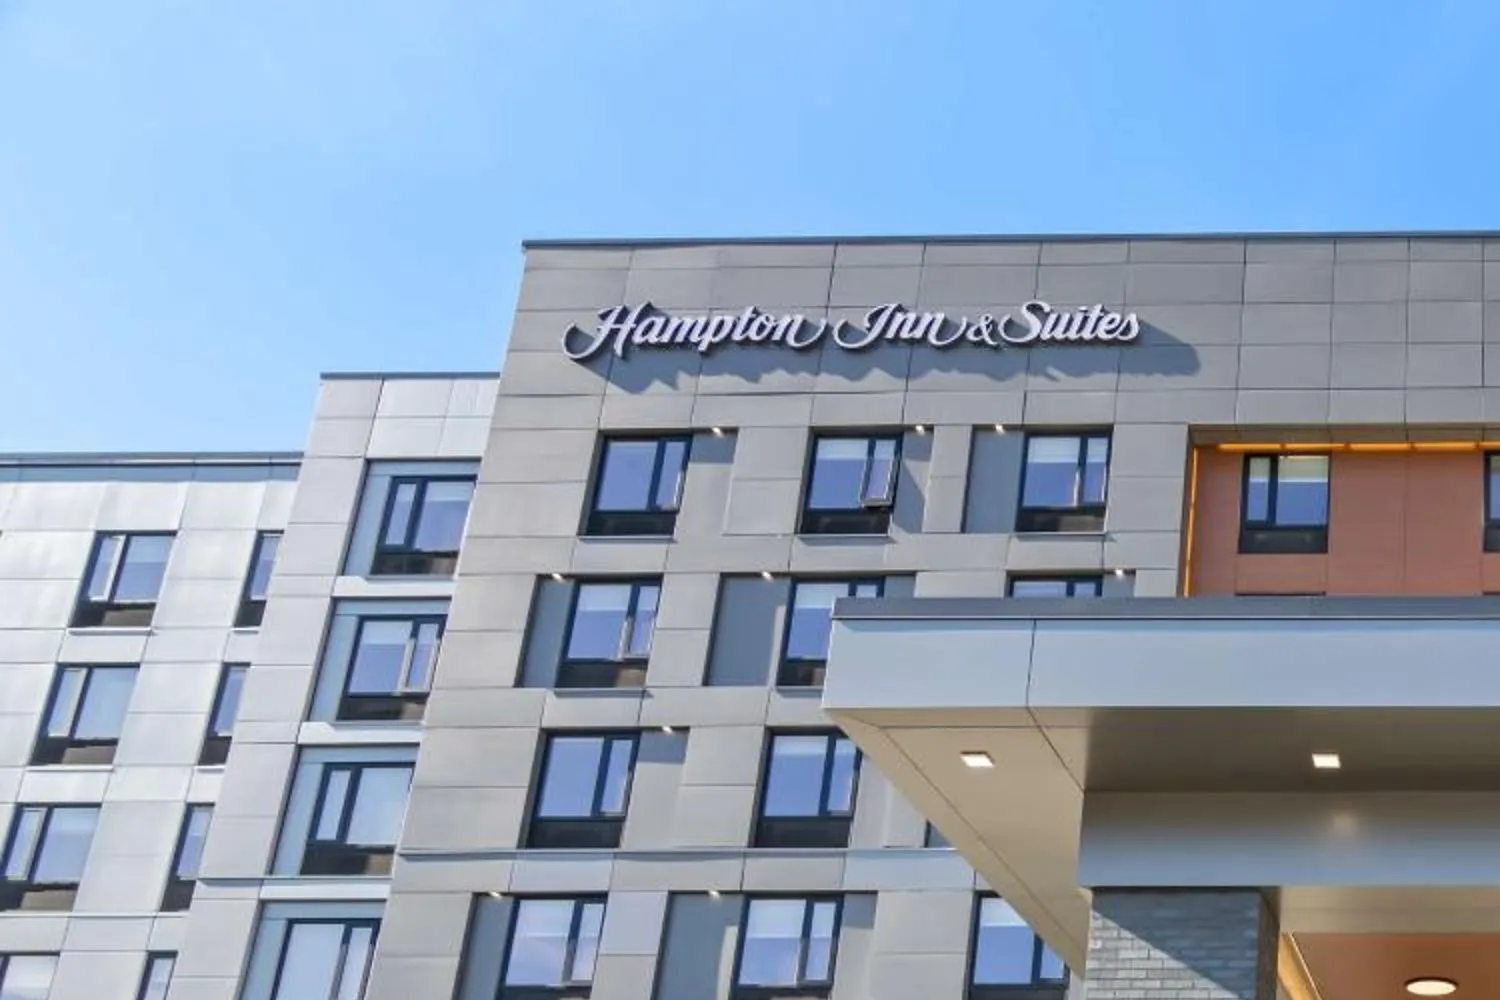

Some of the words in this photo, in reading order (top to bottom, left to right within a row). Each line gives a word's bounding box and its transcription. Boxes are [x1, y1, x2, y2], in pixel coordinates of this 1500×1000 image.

[562, 301, 828, 359] Hampton
[833, 303, 967, 348] Inn
[998, 300, 1140, 342] Suites
